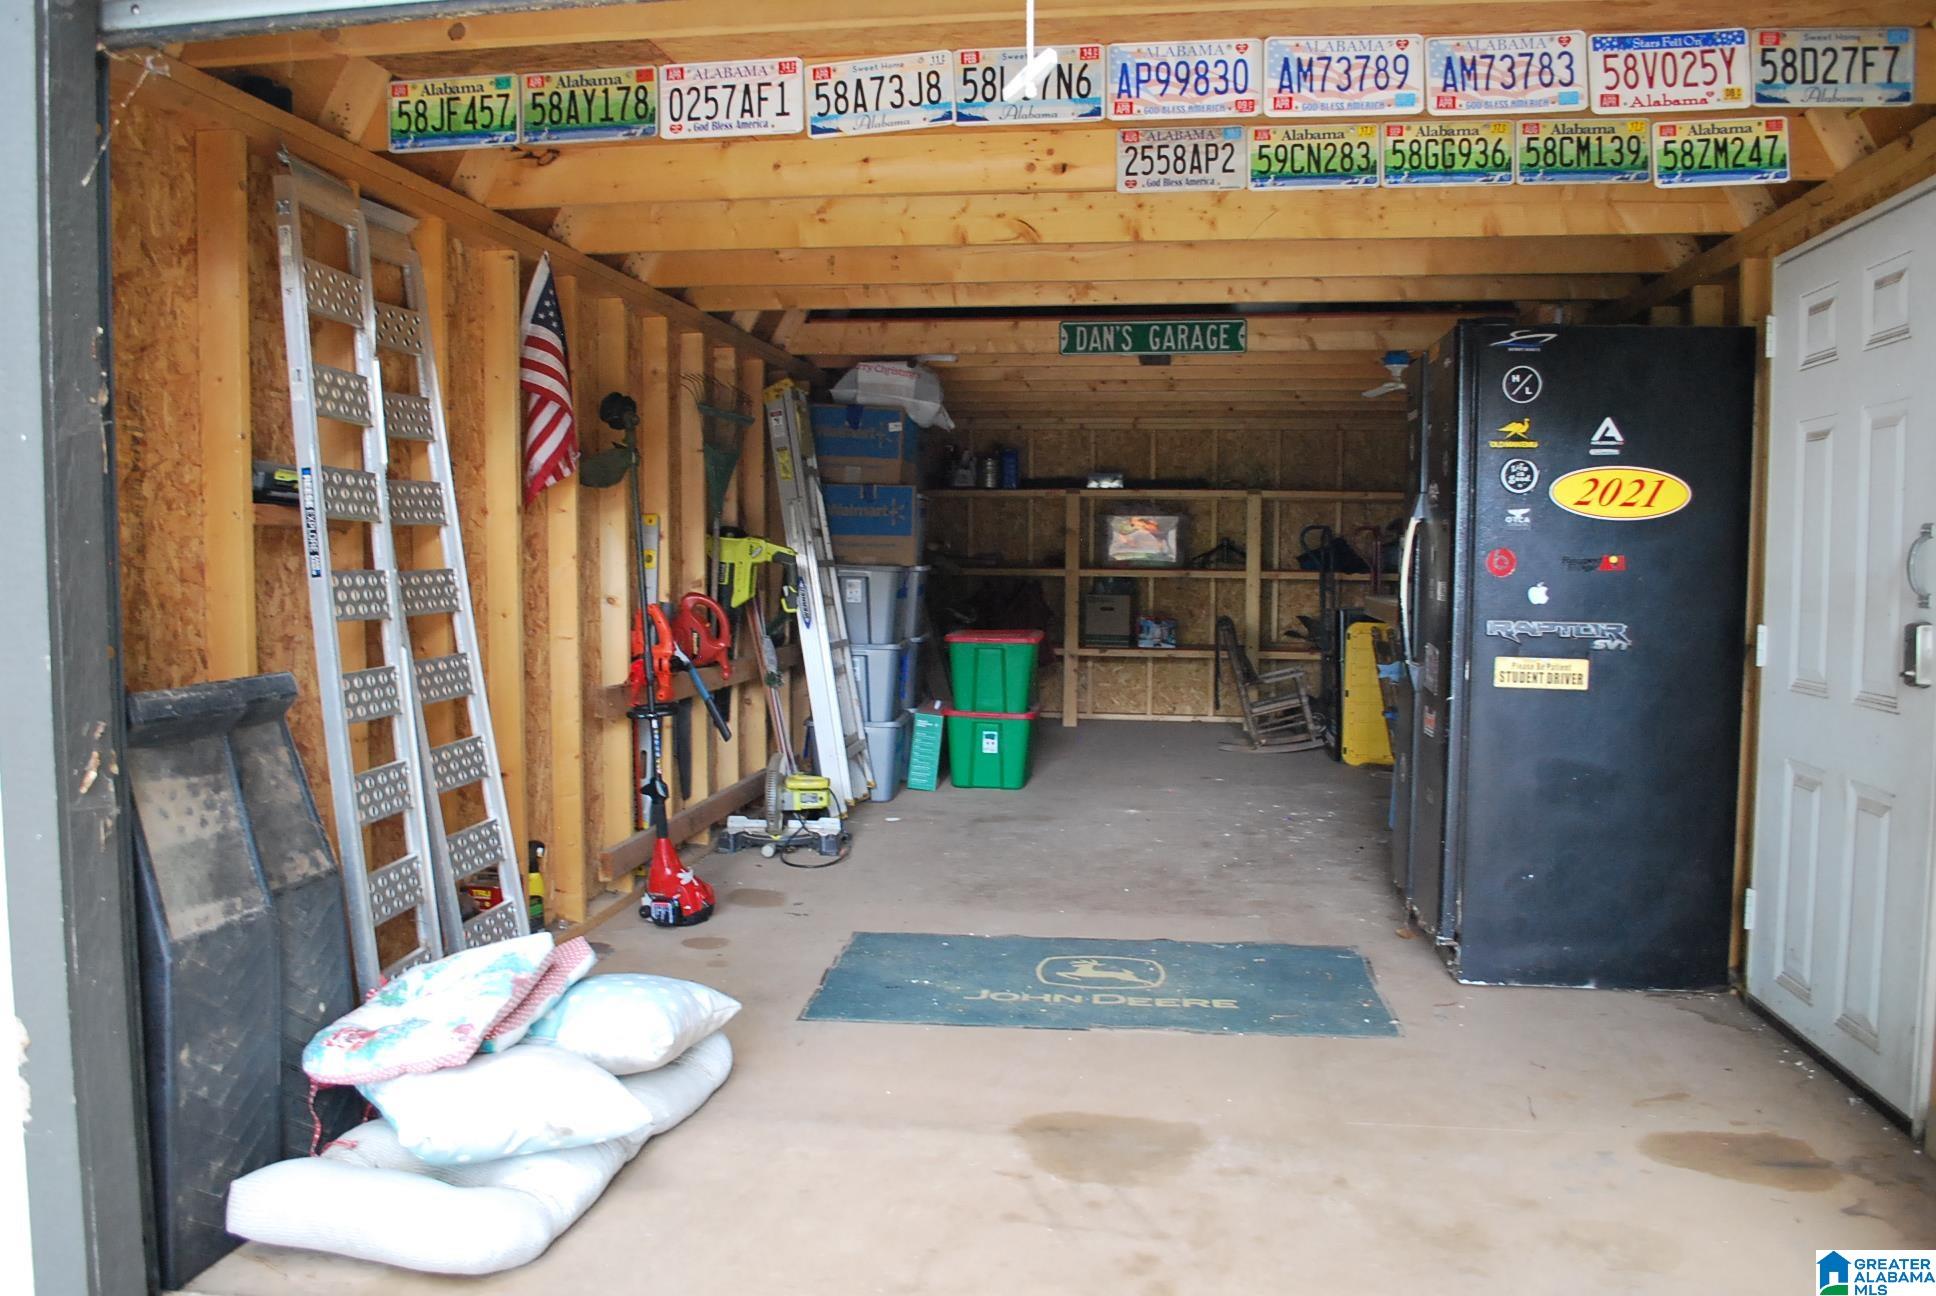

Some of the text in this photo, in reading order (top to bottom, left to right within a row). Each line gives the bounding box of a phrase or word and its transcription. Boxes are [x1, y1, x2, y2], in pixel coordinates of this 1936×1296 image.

[1143, 44, 1225, 58] ALABAMA
[1302, 40, 1385, 53] ALABAMA
[1463, 38, 1547, 51] ALABAMA
[1632, 35, 1703, 49] Stars Fell On
[693, 65, 769, 81] ALABAMA
[1277, 54, 1410, 94] AM73789
[1441, 51, 1575, 92] AM73783
[1603, 47, 1736, 91] 58V025Y
[1760, 46, 1900, 85] 58D27F7
[556, 74, 623, 89] Alabama
[963, 63, 1092, 103] 587N6
[1117, 58, 1249, 99] AP99830
[421, 82, 485, 97] Alabama
[815, 70, 942, 117] 58A73J8
[531, 84, 649, 125] 58AY178
[669, 81, 790, 122] 0257AF1
[1629, 93, 1708, 108] Alabama
[398, 93, 510, 134] 58JF457
[852, 113, 911, 130] Alabama
[998, 104, 1058, 121] Alabama
[693, 122, 711, 132] God
[1146, 130, 1217, 141] ALABAMA
[1281, 129, 1346, 141] Alabama
[1416, 125, 1480, 137] Alabama
[1551, 123, 1616, 135] Alabama
[1688, 123, 1753, 136] Alabama
[1125, 143, 1236, 176] 2558AP2
[1257, 141, 1371, 174] 59CN283
[1391, 137, 1506, 170] 58GG936
[1526, 135, 1641, 168] 58CM139
[1663, 135, 1779, 171] 58ZM247
[1076, 324, 1231, 351] DAN'S GARAGE
[1573, 477, 1666, 508] 2021
[1486, 619, 1633, 644] RAPTOR
[1511, 662, 1534, 670] Please
[1499, 670, 1584, 686] STUDENT DRIVER
[963, 988, 1240, 1009] JOHN DEERE
